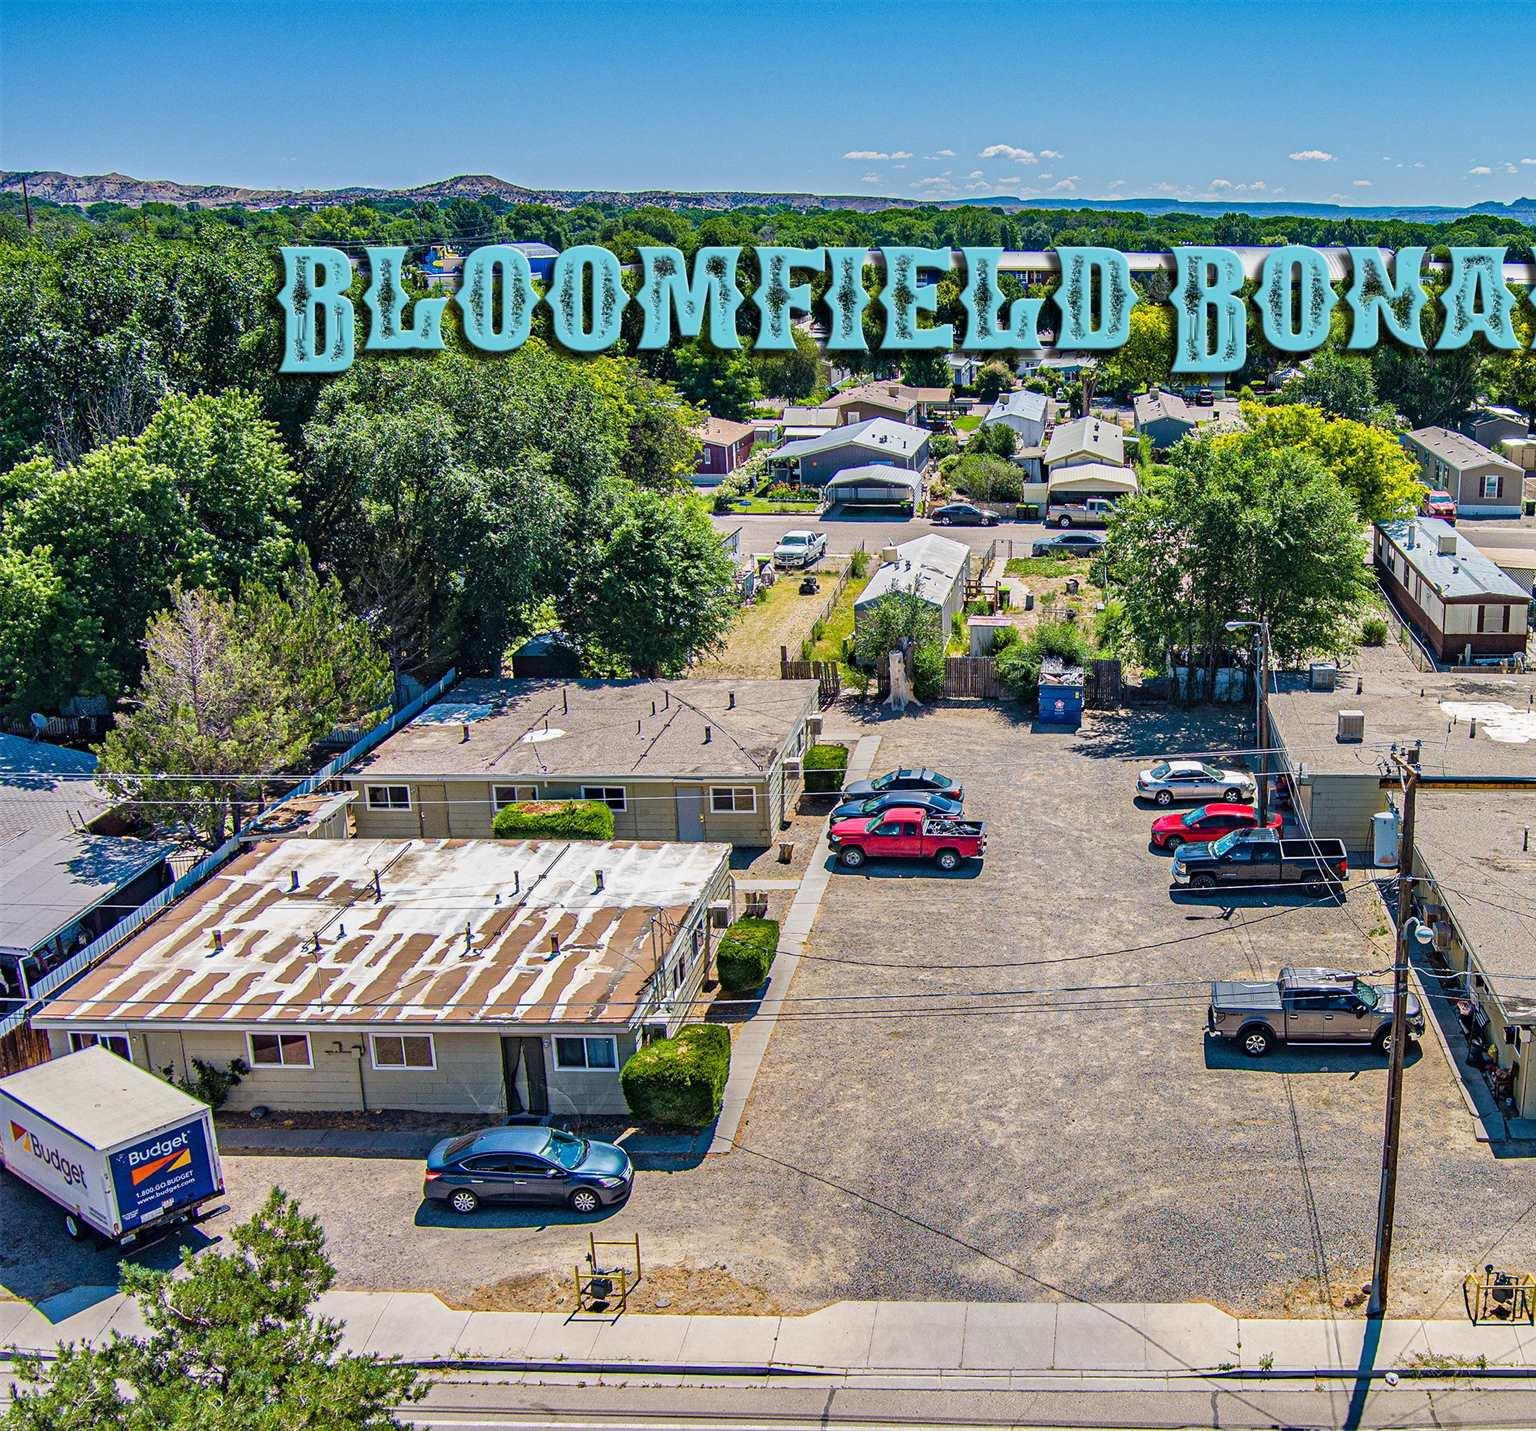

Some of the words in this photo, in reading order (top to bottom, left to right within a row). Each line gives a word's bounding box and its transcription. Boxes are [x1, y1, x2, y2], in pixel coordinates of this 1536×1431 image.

[29, 1132, 87, 1189] Budget
[128, 1132, 189, 1166] Budget
[137, 1177, 195, 1205] www.budget.com
